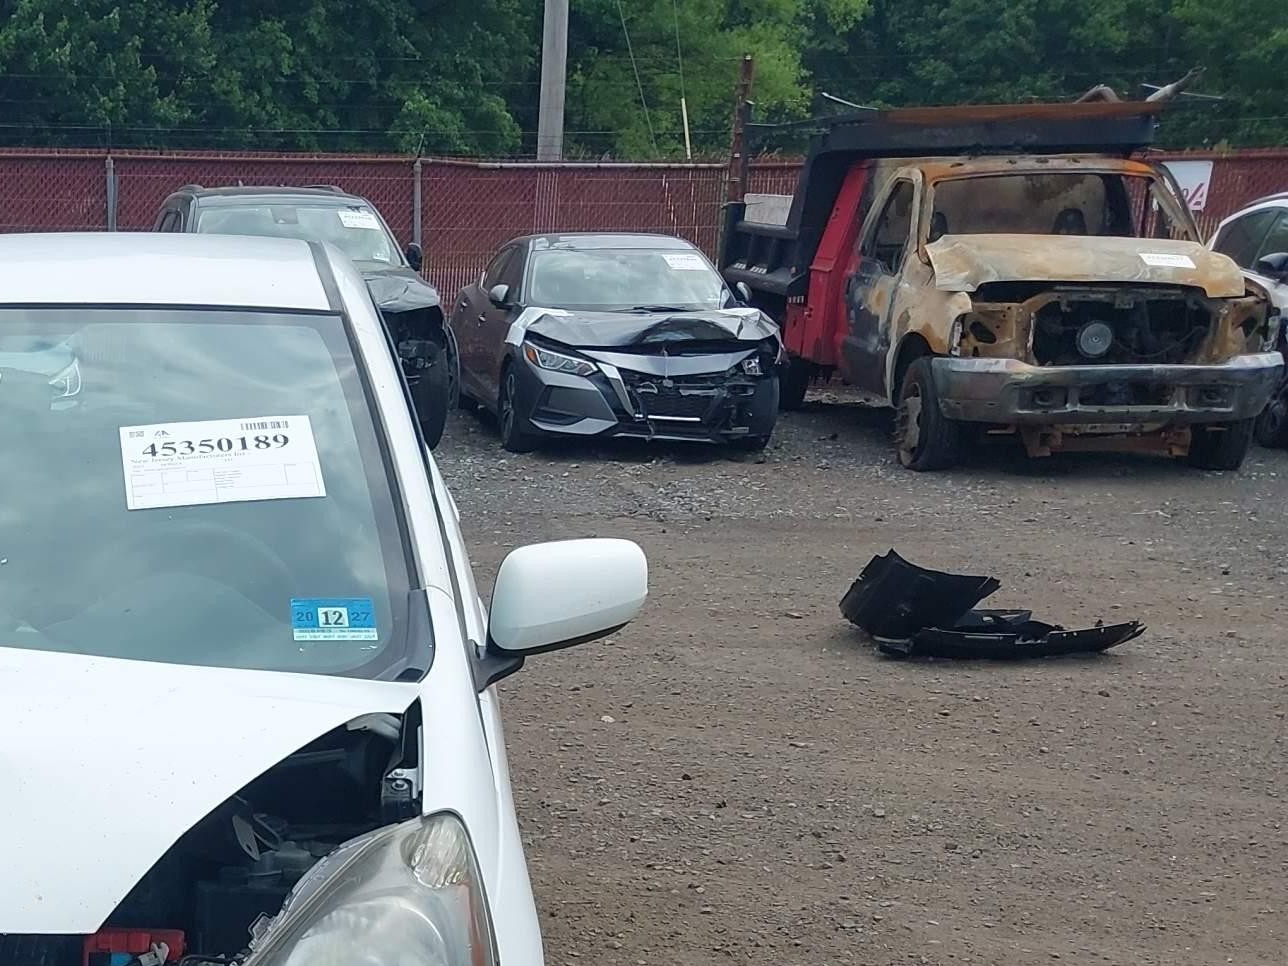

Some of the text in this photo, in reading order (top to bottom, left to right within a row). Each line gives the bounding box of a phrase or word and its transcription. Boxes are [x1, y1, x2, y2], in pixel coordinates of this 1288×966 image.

[142, 434, 289, 457] 45350189
[295, 610, 371, 625] 20 12 27
